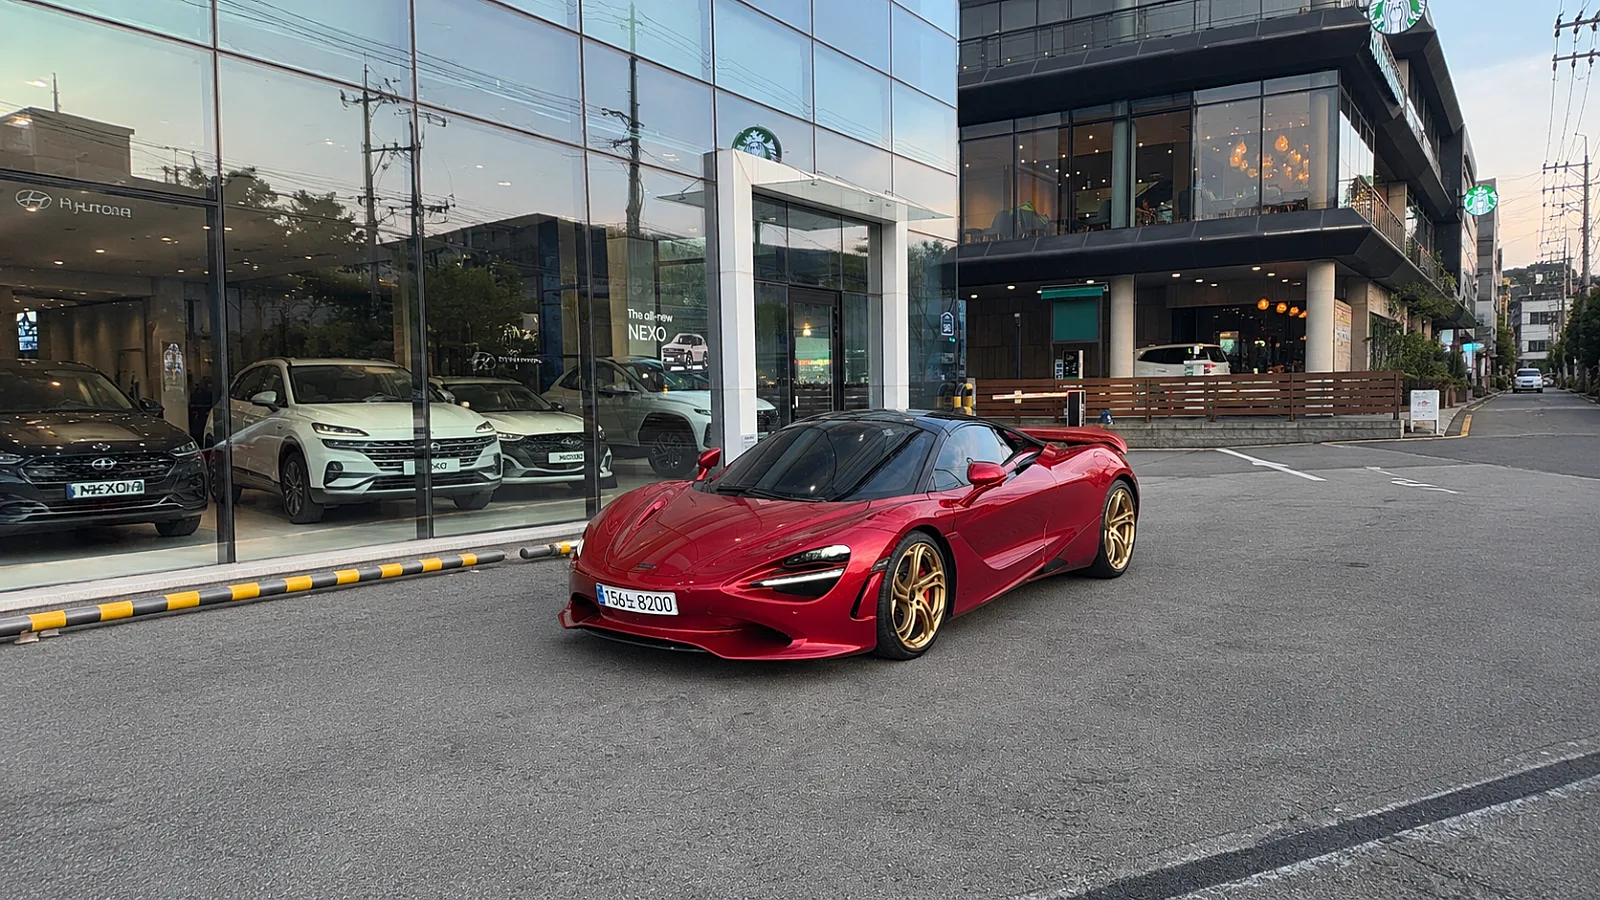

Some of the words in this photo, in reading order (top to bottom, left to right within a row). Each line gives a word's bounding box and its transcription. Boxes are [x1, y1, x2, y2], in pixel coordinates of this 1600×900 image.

[627, 308, 643, 320] The
[643, 310, 673, 323] all-new
[628, 323, 667, 342] NEXO
[605, 589, 635, 609] 156노
[637, 594, 673, 612] 8200
